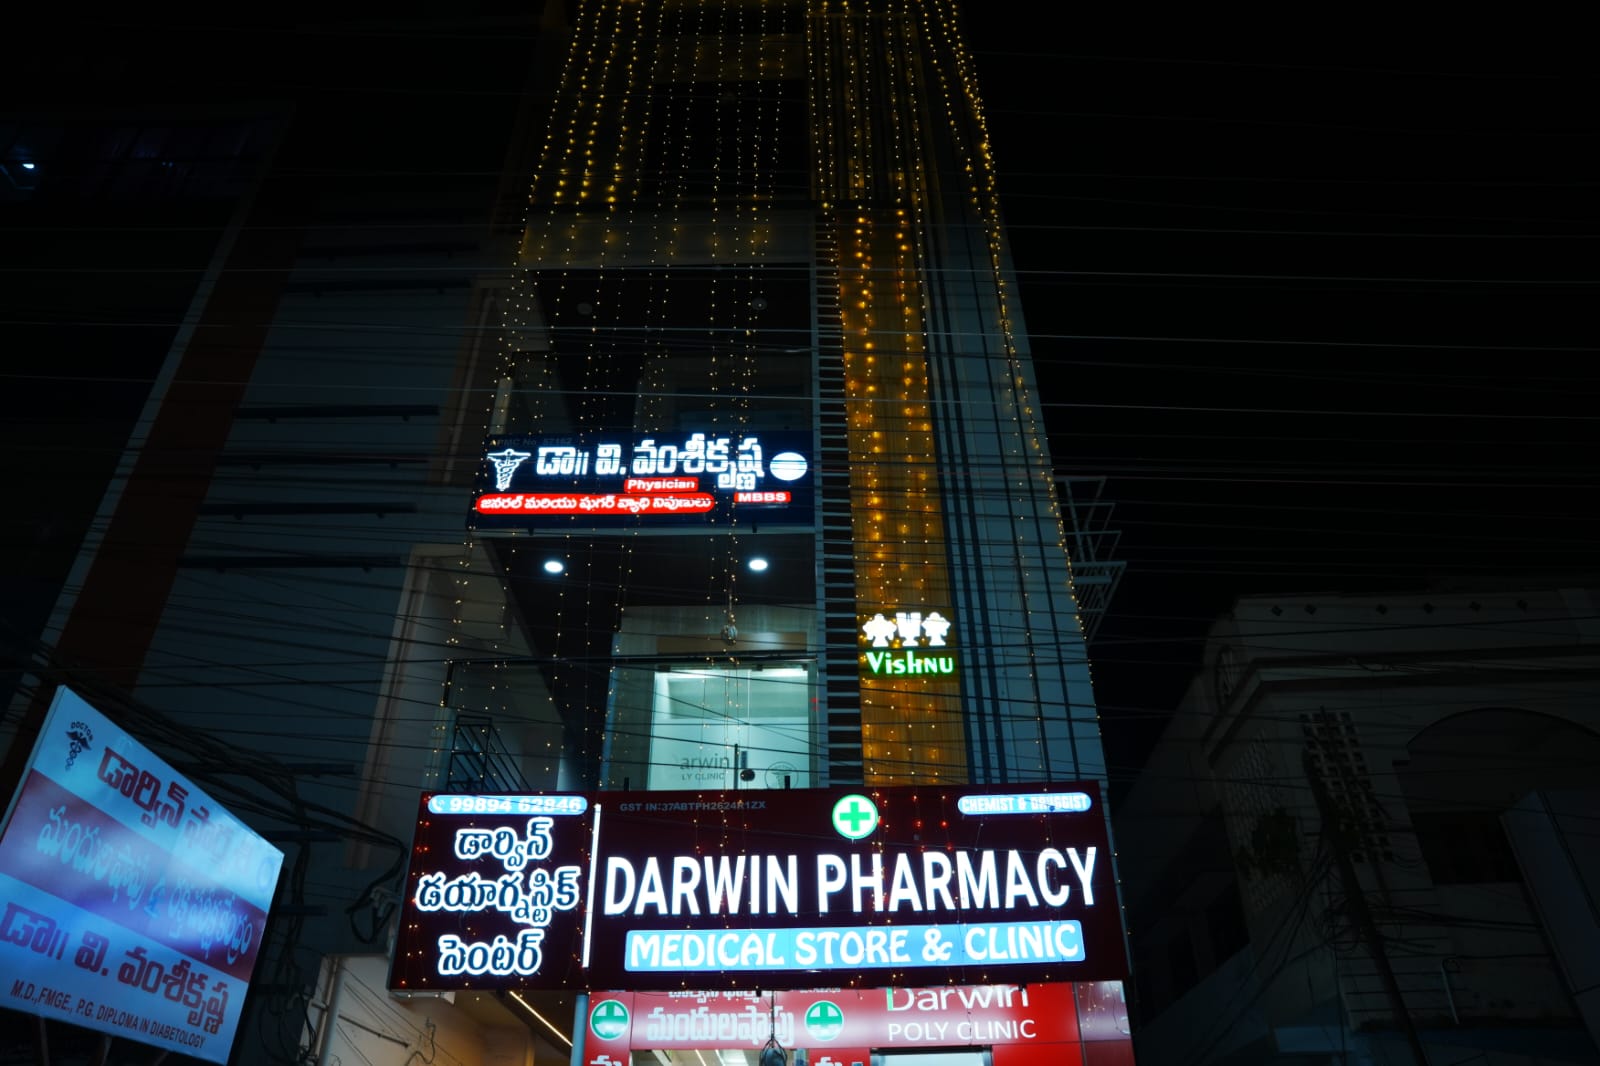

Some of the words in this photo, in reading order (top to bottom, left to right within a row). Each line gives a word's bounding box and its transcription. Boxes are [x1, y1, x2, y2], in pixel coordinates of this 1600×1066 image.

[633, 433, 764, 490] వంశీకృష్ణ
[627, 479, 695, 492] Physician
[738, 493, 787, 503] MBBS
[481, 495, 523, 509] జనరల్
[525, 496, 576, 509] మరియు
[579, 494, 615, 510] షుగర్
[617, 496, 650, 512] వ్యాధి
[70, 721, 93, 741] DOCTOR
[677, 753, 730, 770] arwin
[97, 746, 189, 829] డార్విన్
[695, 772, 726, 781] CLINIC
[450, 797, 511, 812] 99894
[518, 797, 582, 812] 62846
[619, 803, 642, 812] GST
[962, 797, 1014, 812] CHEMIST
[1018, 797, 1026, 811] &
[455, 817, 554, 871] డార్విన్
[604, 854, 798, 917] DARWIN
[816, 846, 1097, 914] PHARMACY
[416, 866, 581, 927] డయాగ్నస్టిక్
[438, 929, 545, 975] సెంటర్
[630, 931, 785, 967] MEDICAL
[794, 930, 909, 965] STORE
[921, 927, 954, 962] &
[965, 924, 1079, 961] CLINIC
[118, 945, 229, 1035] వంశీకృష్ణ
[886, 985, 1030, 1012] Darwin
[77, 998, 95, 1017] P.G.
[96, 1005, 140, 1032] DIPLOMA
[140, 1017, 150, 1032] IN
[150, 1021, 206, 1049] DIABETOLOGY
[888, 1021, 950, 1042] POLY
[956, 1019, 1037, 1041] CLINIC
